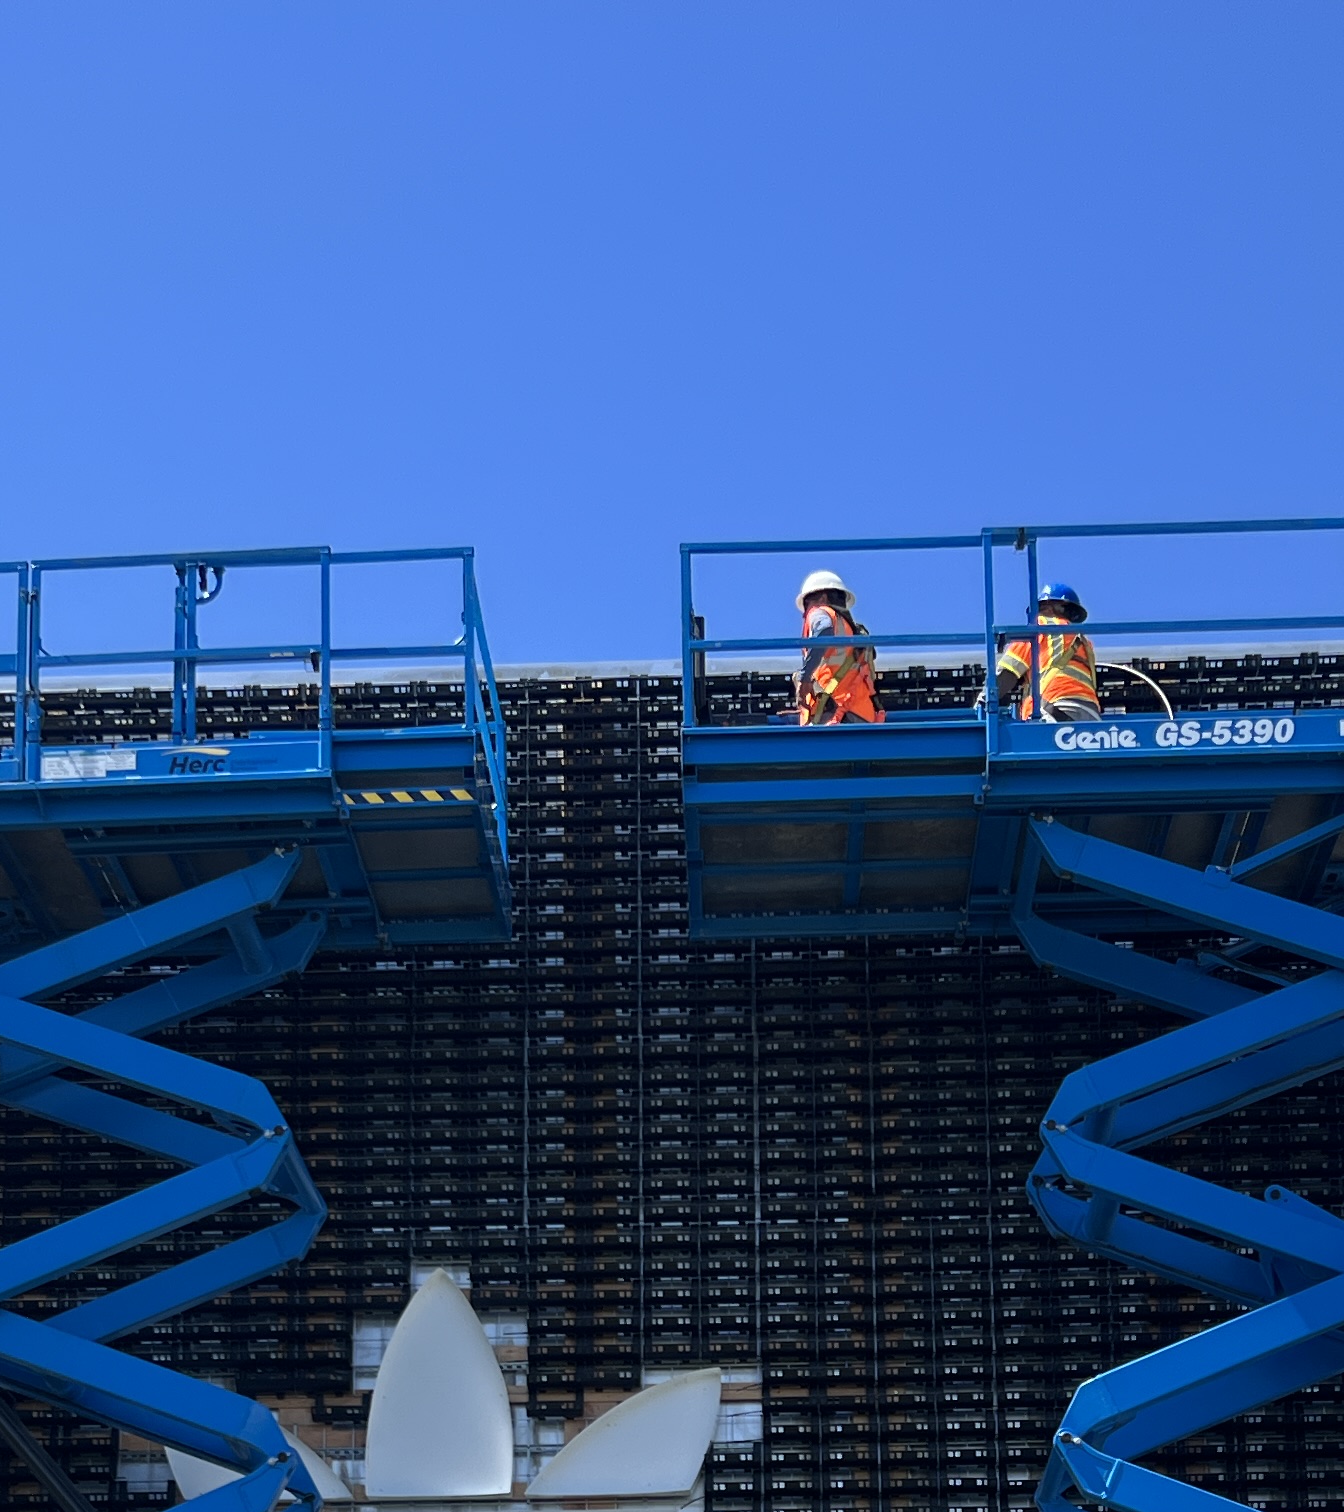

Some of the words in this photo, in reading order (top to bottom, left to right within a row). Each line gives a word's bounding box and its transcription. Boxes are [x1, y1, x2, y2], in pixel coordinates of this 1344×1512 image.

[1054, 725, 1138, 750] Genie
[1155, 718, 1295, 747] GS-5390
[168, 756, 226, 775] Herc
